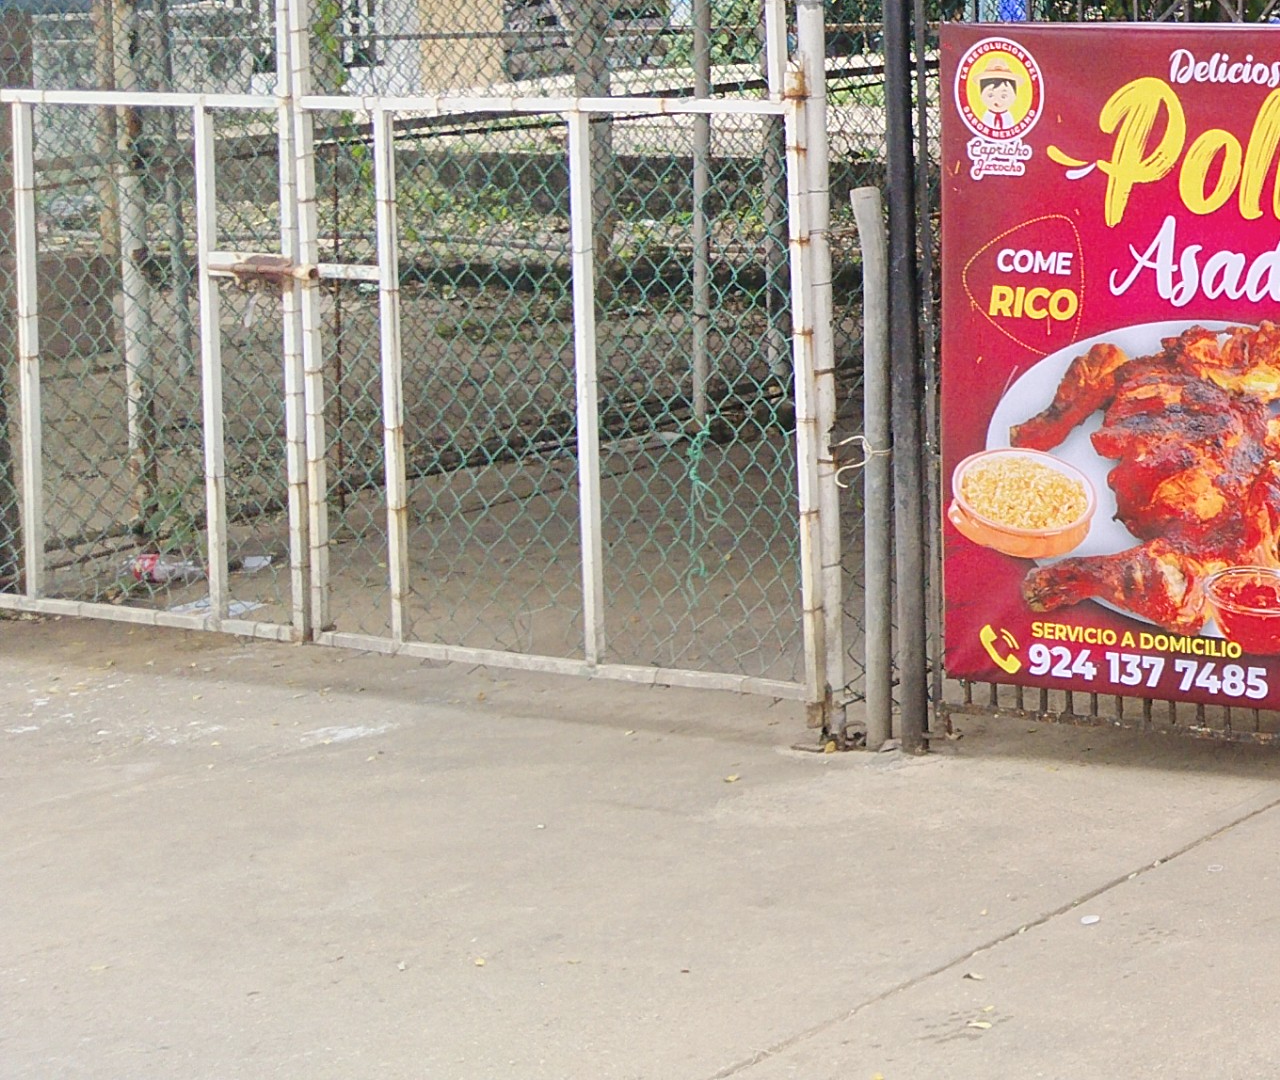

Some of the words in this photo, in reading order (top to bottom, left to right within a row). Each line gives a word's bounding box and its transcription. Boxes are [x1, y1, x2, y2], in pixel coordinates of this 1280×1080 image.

[966, 42, 1026, 64] REVOLUCION
[1024, 60, 1038, 81] DEL
[962, 105, 990, 136] SABOR
[992, 108, 1037, 139] MEXICANO
[969, 137, 1030, 161] Capricho
[973, 159, 1023, 177] Jarocho
[997, 247, 1074, 277] COME
[988, 285, 1079, 322] RICO
[1031, 621, 1118, 646] SERVICIO
[1120, 631, 1136, 648] A
[1028, 643, 1098, 681] 924
[1105, 651, 1165, 688] 137
[1174, 659, 1269, 699] 7485
